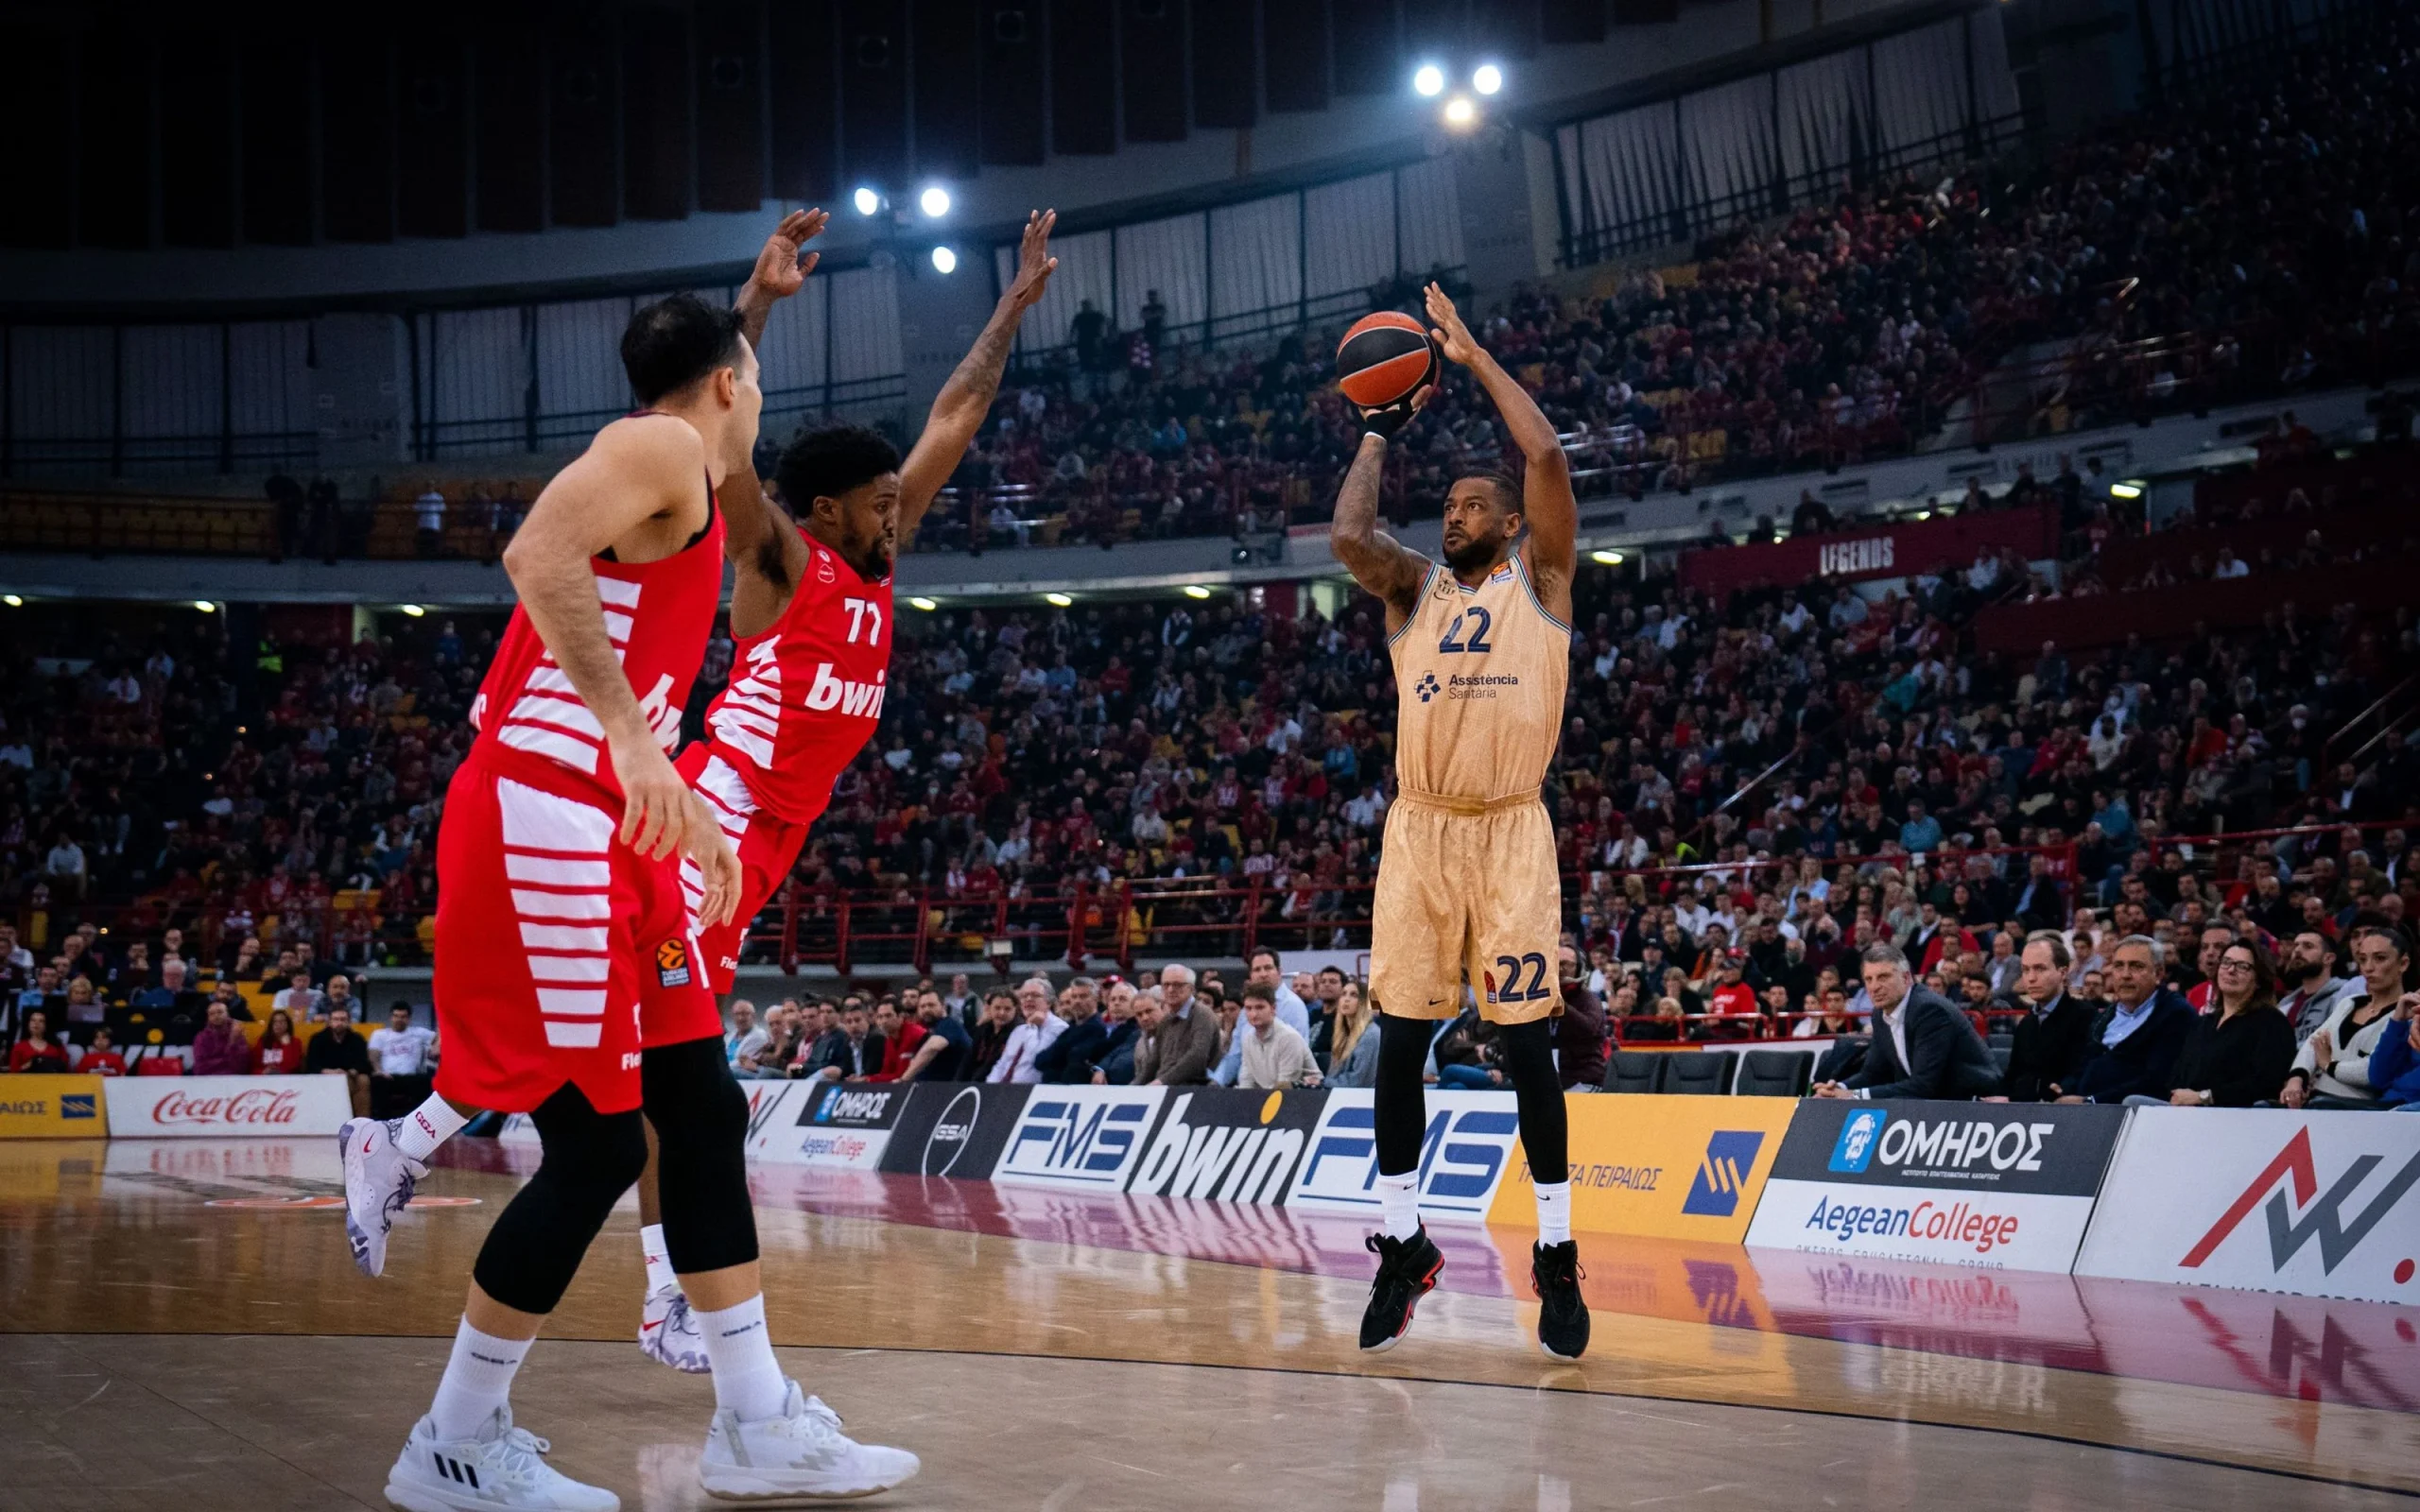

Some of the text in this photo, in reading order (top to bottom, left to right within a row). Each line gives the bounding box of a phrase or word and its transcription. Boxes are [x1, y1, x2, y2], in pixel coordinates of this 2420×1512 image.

[1820, 536, 1894, 577] LEGENDS
[844, 598, 881, 646] 77
[1439, 606, 1492, 654] 22
[805, 663, 887, 719] bwi
[1448, 687, 1497, 699] Sanitària
[1449, 673, 1518, 686] Assistència
[1496, 952, 1551, 1003] 22
[0, 1100, 46, 1115] ΑΙΩΣ
[152, 1088, 301, 1125] Coca-Cola
[831, 1091, 891, 1120] ΟΜΗΡΟΣ
[1008, 1101, 1150, 1172] FMS
[1130, 1090, 1305, 1205] bwin
[1877, 1119, 2055, 1171] ΟΜΗΡΟΣ
[1585, 1164, 1663, 1191] ΠΕΙΡΑΙΩΣ
[1806, 1194, 2018, 1254] AegeanCollege
